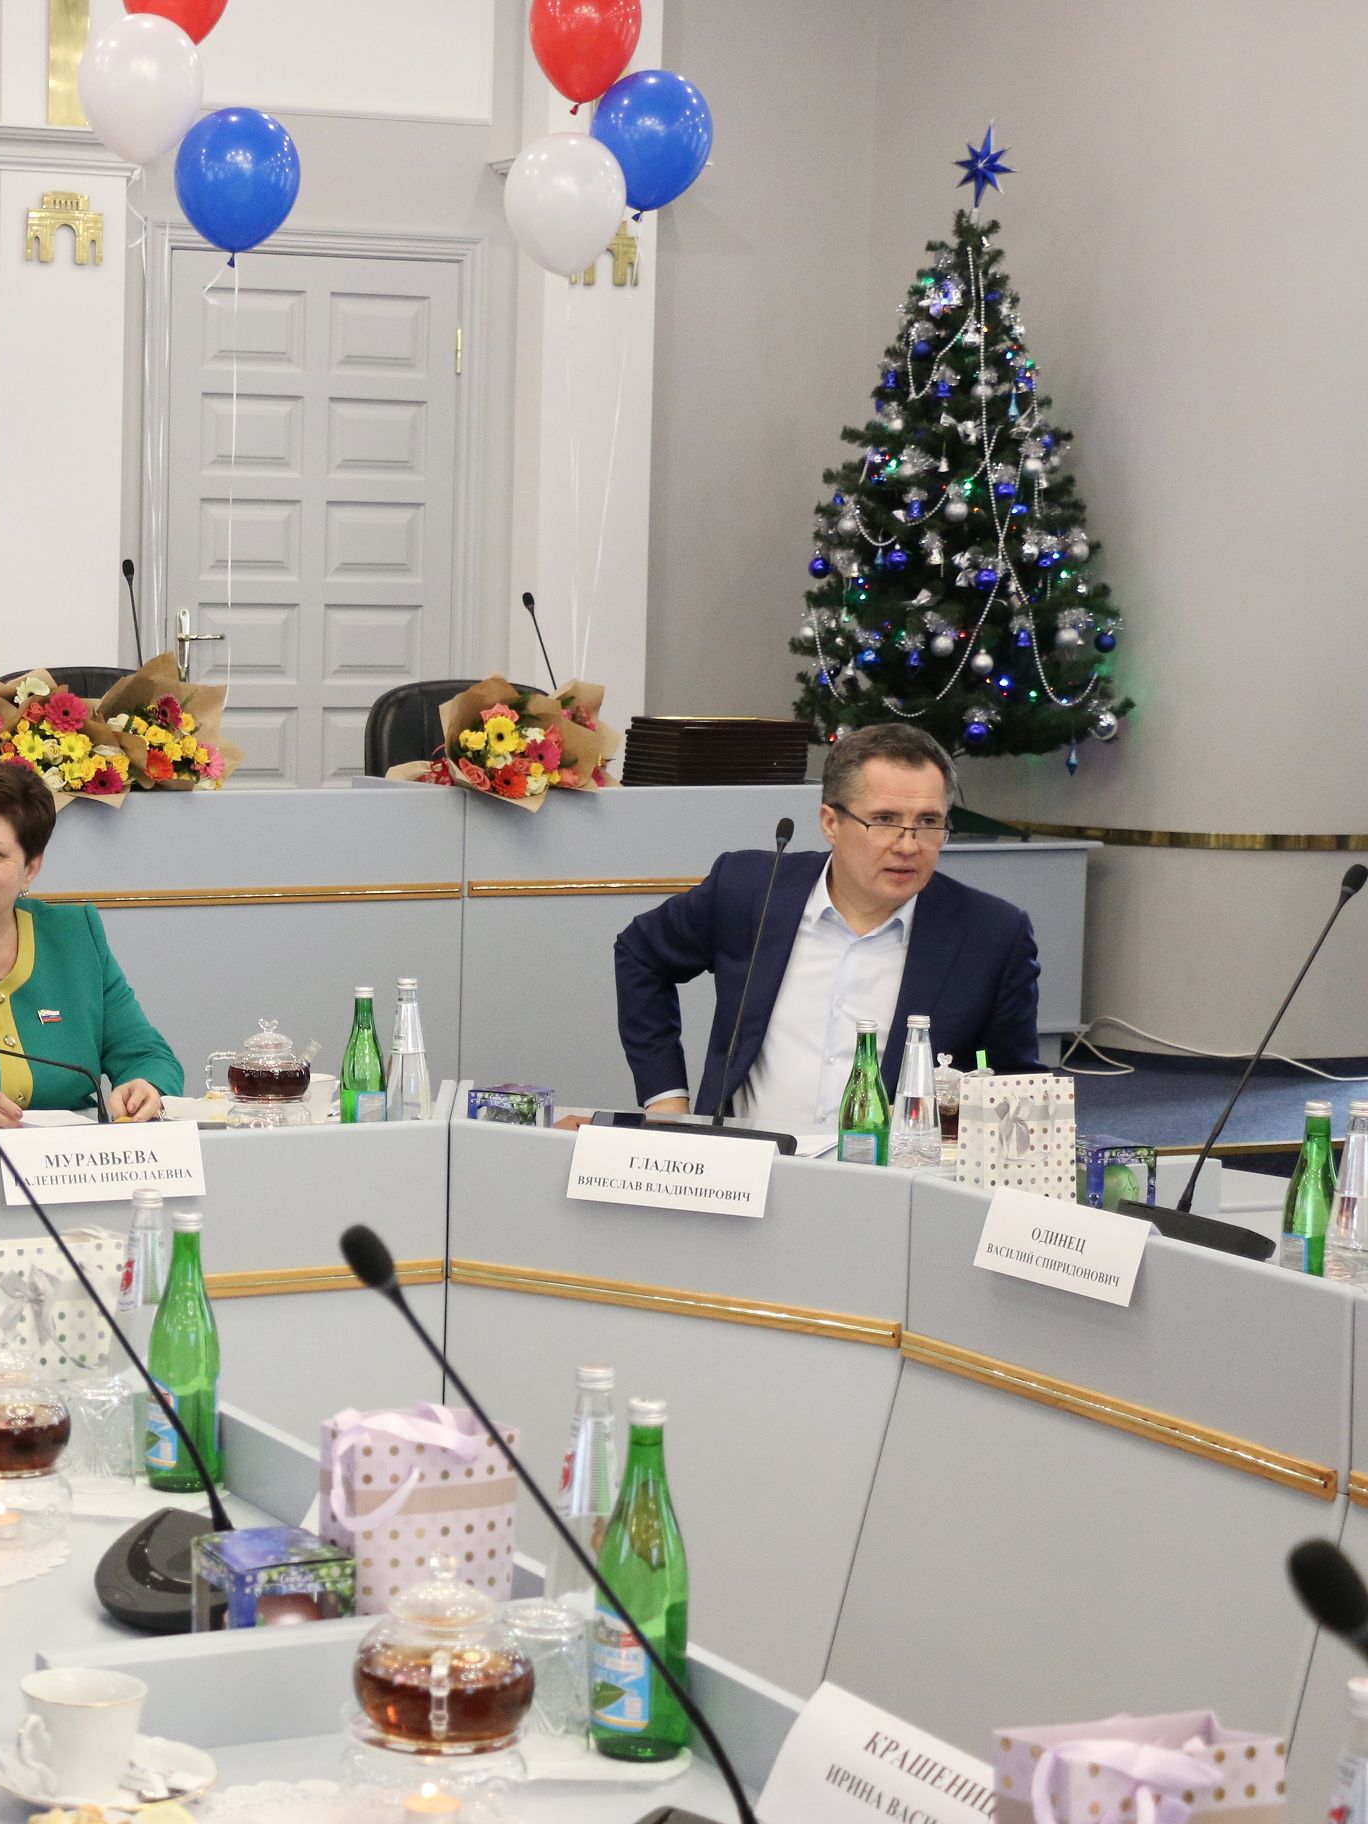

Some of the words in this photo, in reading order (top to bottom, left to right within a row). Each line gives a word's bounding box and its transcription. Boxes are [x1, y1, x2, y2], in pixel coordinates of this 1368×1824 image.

[44, 1149, 159, 1168] МУРАВЬЕВА
[629, 1156, 705, 1176] ГЛАДКОВ
[15, 1173, 97, 1187] АЛЕНТИНА
[101, 1168, 193, 1183] НИКОЛАЕВНА
[577, 1175, 642, 1191] ВЯЧЕСЛАВ
[645, 1182, 751, 1202] ВЛАДИМИРОВИЧ
[1031, 1227, 1087, 1255] ОДИНЕЦ
[986, 1242, 1034, 1265] ВАСИЛИЙ
[1035, 1255, 1120, 1287] СПИРИДОНОВИЧ
[825, 1763, 883, 1810] ИРИНА
